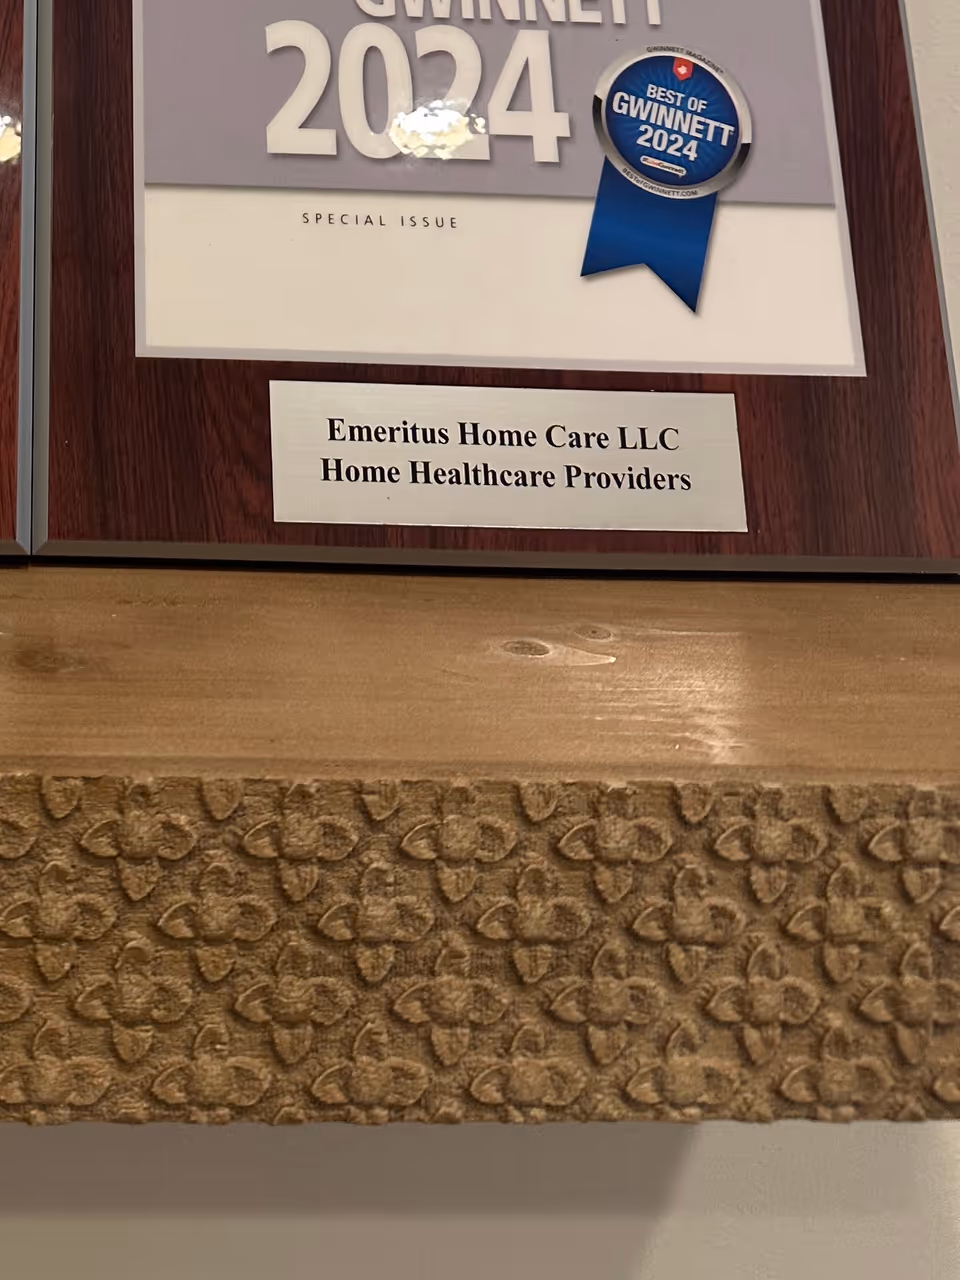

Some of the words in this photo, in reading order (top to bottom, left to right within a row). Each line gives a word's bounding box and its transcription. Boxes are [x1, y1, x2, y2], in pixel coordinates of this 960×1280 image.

[646, 45, 684, 54] GWINNETT
[265, 19, 572, 164] 2024
[646, 83, 685, 107] BEST
[687, 95, 708, 113] OF
[612, 91, 735, 147] GWINNETT
[636, 124, 698, 162] 2024
[302, 212, 387, 227] SPECIAL
[400, 215, 458, 229] ISSUE
[326, 417, 450, 446] Emeritus
[457, 421, 537, 448] Home
[545, 424, 610, 450] Care
[617, 426, 680, 451] LLC
[320, 457, 401, 484] Home
[408, 460, 556, 489] Healthcare
[564, 464, 692, 491] Providers
